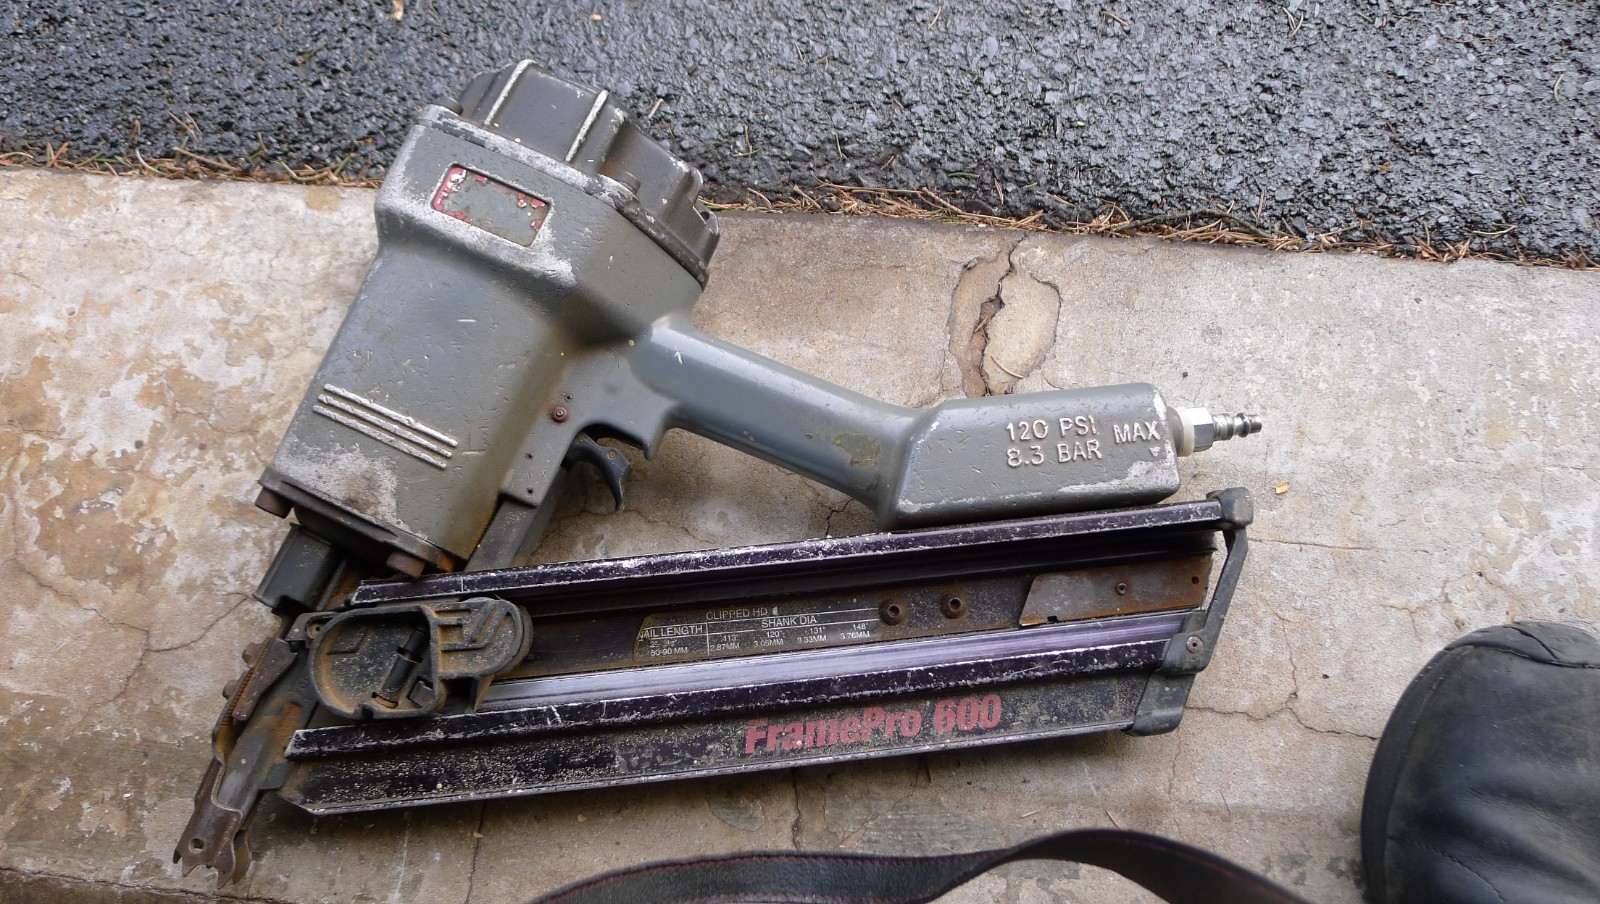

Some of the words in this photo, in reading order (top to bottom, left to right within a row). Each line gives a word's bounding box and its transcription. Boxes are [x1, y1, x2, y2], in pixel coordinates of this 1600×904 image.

[1006, 418, 1049, 441] 120
[1059, 414, 1098, 437] PSI
[1113, 420, 1161, 444] MAX
[1006, 445, 1045, 468] 8.3
[1056, 439, 1103, 463] BAR
[706, 608, 750, 620] CLIPPED
[753, 607, 768, 616] HD
[761, 616, 797, 629] SHANK
[799, 615, 818, 625] DIA
[661, 625, 703, 637] LENGTH
[744, 706, 922, 754] FramePro
[934, 693, 1003, 733] 600
